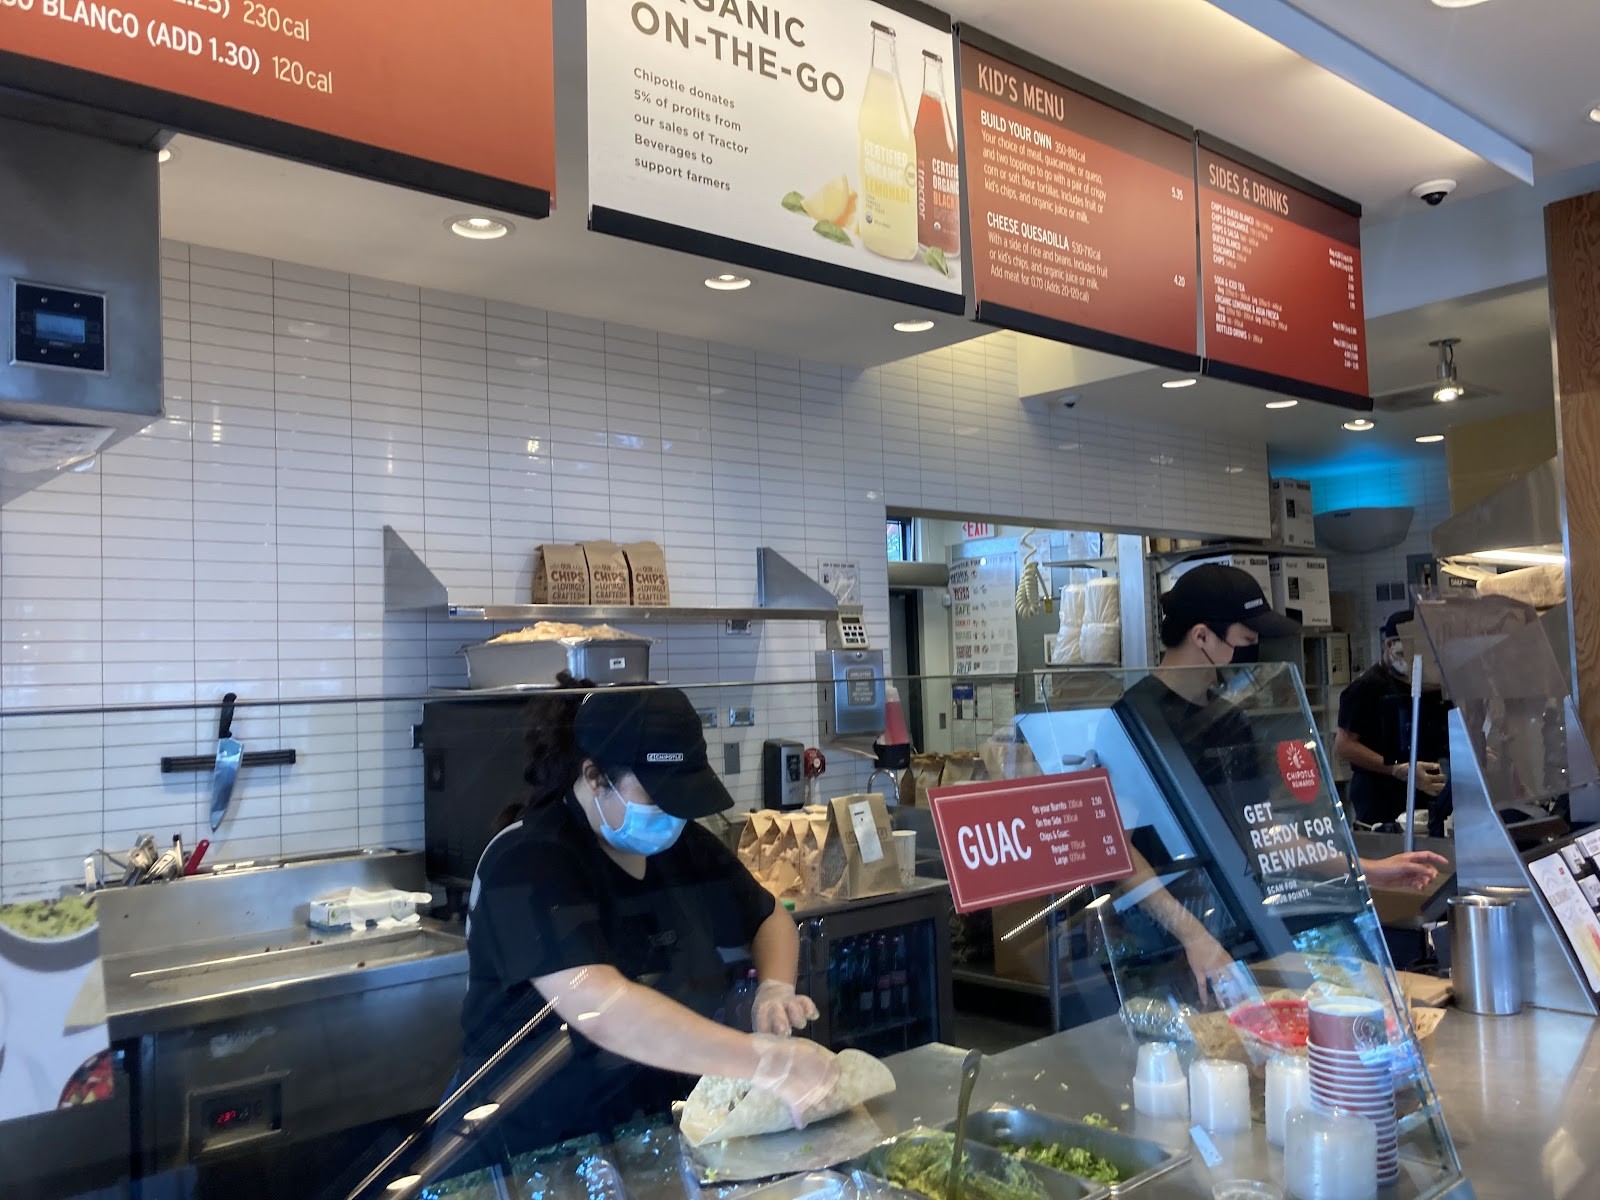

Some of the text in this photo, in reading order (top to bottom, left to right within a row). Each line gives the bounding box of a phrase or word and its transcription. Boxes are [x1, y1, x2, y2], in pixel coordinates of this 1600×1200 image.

[43, 0, 139, 39] BLANCO
[147, 19, 202, 56] (ADD
[209, 37, 260, 75] 1.30)
[631, 2, 845, 101] ON-THE-GO
[634, 67, 736, 109] Chipotle donates
[978, 63, 1065, 121] KID'S MENU
[634, 89, 742, 132] 5% of profits from
[981, 109, 1007, 133] BUILD
[1008, 119, 1032, 143] YOUR
[1034, 130, 1052, 150] OWN
[634, 113, 749, 155] our sales of Tractor
[634, 133, 713, 165] Beverages to
[982, 128, 996, 144] Your
[998, 136, 1017, 153] choice
[1019, 143, 1026, 156] of
[1078, 167, 1084, 178] or
[634, 157, 731, 191] support farmers
[983, 148, 995, 161] and
[996, 149, 1008, 165] two
[1010, 154, 1036, 176] toppings
[1037, 164, 1044, 178] to
[1044, 170, 1052, 182] go
[1053, 172, 1066, 187] with
[1071, 180, 1082, 192] pair
[1083, 182, 1090, 194] of
[1091, 186, 1107, 203] crispy
[984, 163, 998, 178] corn
[1000, 169, 1007, 180] or
[1009, 172, 1020, 186] soft
[1022, 174, 1036, 190] flour
[1085, 196, 1096, 213] fruit
[1097, 204, 1104, 215] or
[1209, 163, 1289, 215] SIDES & DRINKS
[984, 177, 999, 194] kid's
[1019, 191, 1031, 204] and
[1054, 201, 1068, 217] juice
[1069, 208, 1076, 220] or
[987, 211, 1020, 236] CHEESE
[1021, 222, 1070, 251] QUESADILLA
[988, 229, 1003, 245] With
[1003, 237, 1008, 249] a
[1009, 238, 1022, 252] side
[1022, 241, 1029, 254] of
[1030, 245, 1042, 258] rice
[1042, 249, 1054, 262] and
[1073, 257, 1096, 275] Includes
[1097, 264, 1109, 279] fruit
[989, 249, 997, 260] or
[998, 249, 1012, 265] kid's
[1030, 261, 1042, 274] and
[1043, 265, 1064, 280] organic
[1065, 269, 1079, 285] juice
[1080, 276, 1086, 287] or
[991, 263, 1003, 279] Add
[1004, 270, 1020, 283] meat
[1021, 271, 1030, 286] for
[551, 570, 585, 582] CHIPS
[557, 583, 585, 591] LOVINGLY
[593, 571, 626, 582] CHIPS
[596, 591, 623, 599] CRAFTED
[635, 573, 666, 585] CHIPS
[641, 584, 666, 593] LOVINGLY
[553, 591, 581, 600] CRAFTED
[1286, 769, 1315, 781] CHIPOTLE
[1243, 801, 1273, 824] GET
[957, 817, 1032, 870] GUAC
[1250, 816, 1335, 849] READY FOR
[1258, 839, 1343, 875] REWARDS.
[1267, 880, 1297, 895] SCAN FOR
